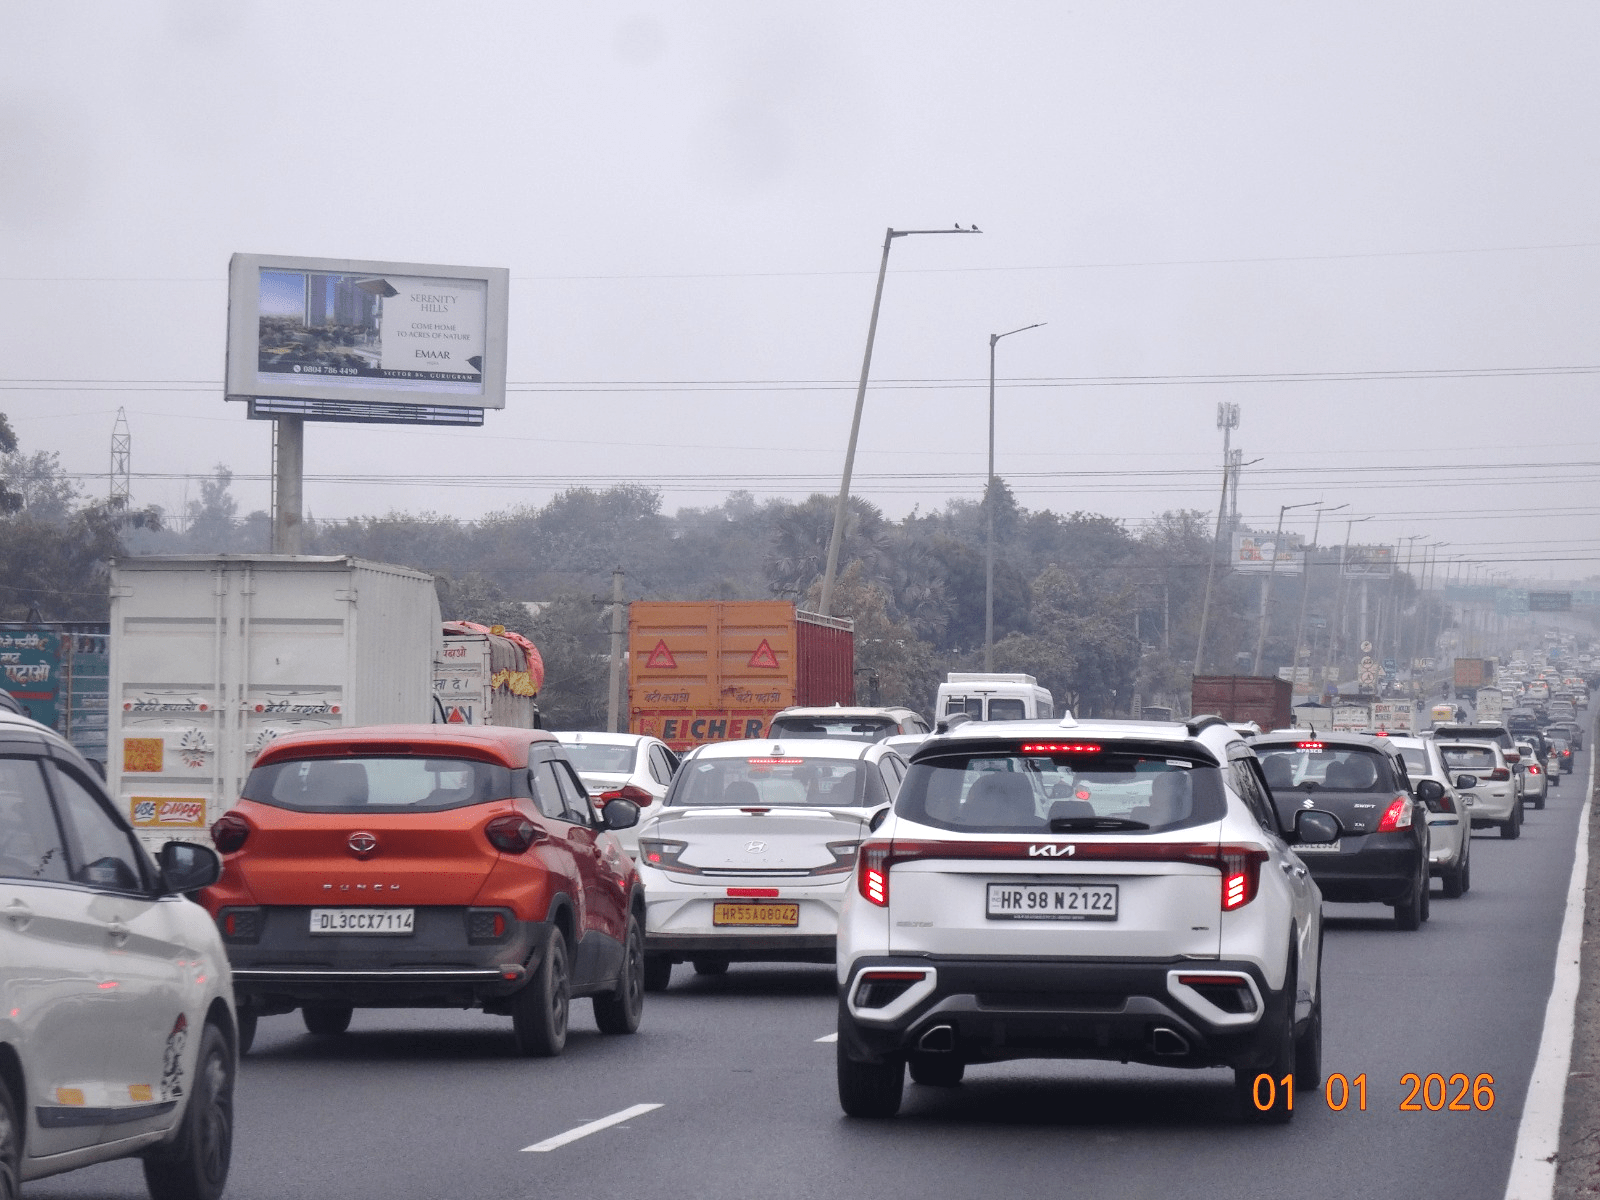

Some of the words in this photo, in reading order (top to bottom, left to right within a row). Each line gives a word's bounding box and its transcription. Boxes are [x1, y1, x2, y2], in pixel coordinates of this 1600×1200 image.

[410, 293, 459, 304] SERENITY
[421, 303, 449, 313] HILLS
[411, 322, 433, 330] COME
[434, 323, 457, 331] HOME
[415, 349, 451, 359] EMAAR
[339, 367, 358, 375] 4490
[663, 719, 763, 739] EICHER
[134, 802, 156, 816] USE
[159, 802, 201, 817] DIPPER
[1029, 844, 1075, 856] KIA
[1001, 891, 1022, 909] HR
[1027, 891, 1048, 909] 98
[1054, 892, 1064, 909] N
[1068, 892, 1113, 910] 2122
[320, 913, 412, 929] DL3CCX7114
